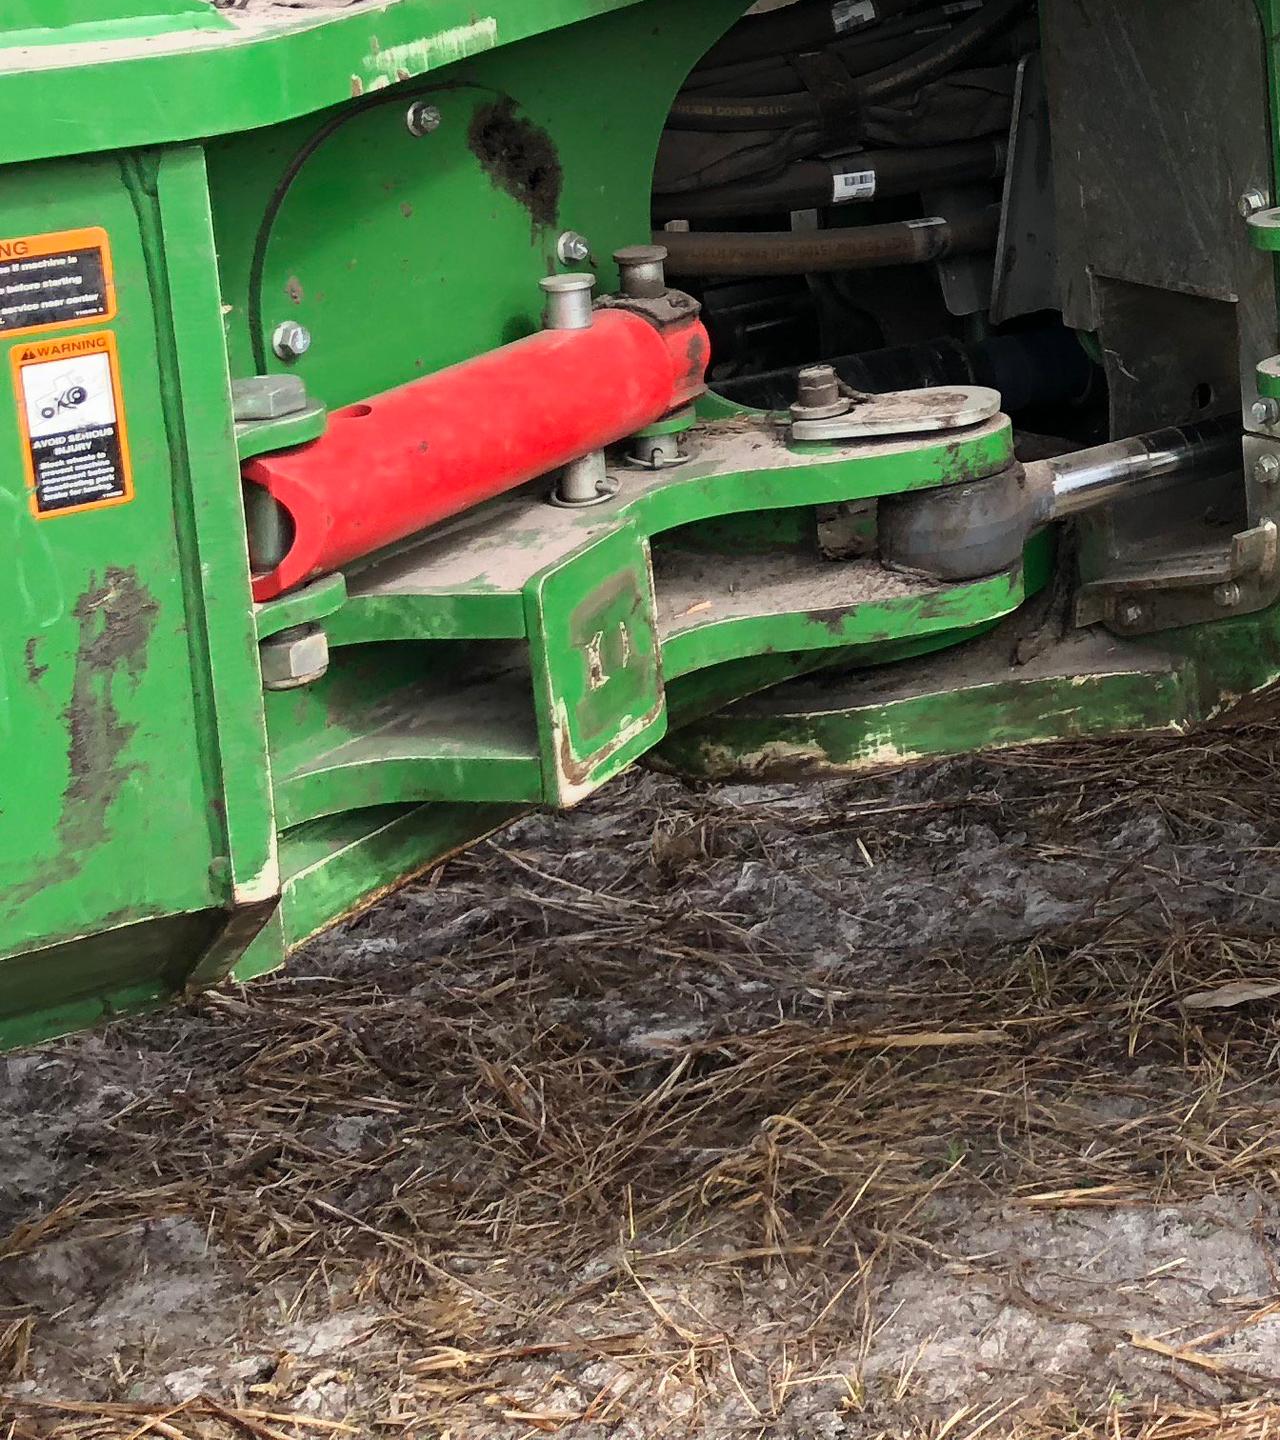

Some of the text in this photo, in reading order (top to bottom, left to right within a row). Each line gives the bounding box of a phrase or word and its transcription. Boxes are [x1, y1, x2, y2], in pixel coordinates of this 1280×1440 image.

[42, 275, 83, 288] starting
[37, 337, 107, 357] WARNING
[32, 427, 114, 449] AVOID SERIOUS
[54, 441, 92, 455] INJURY
